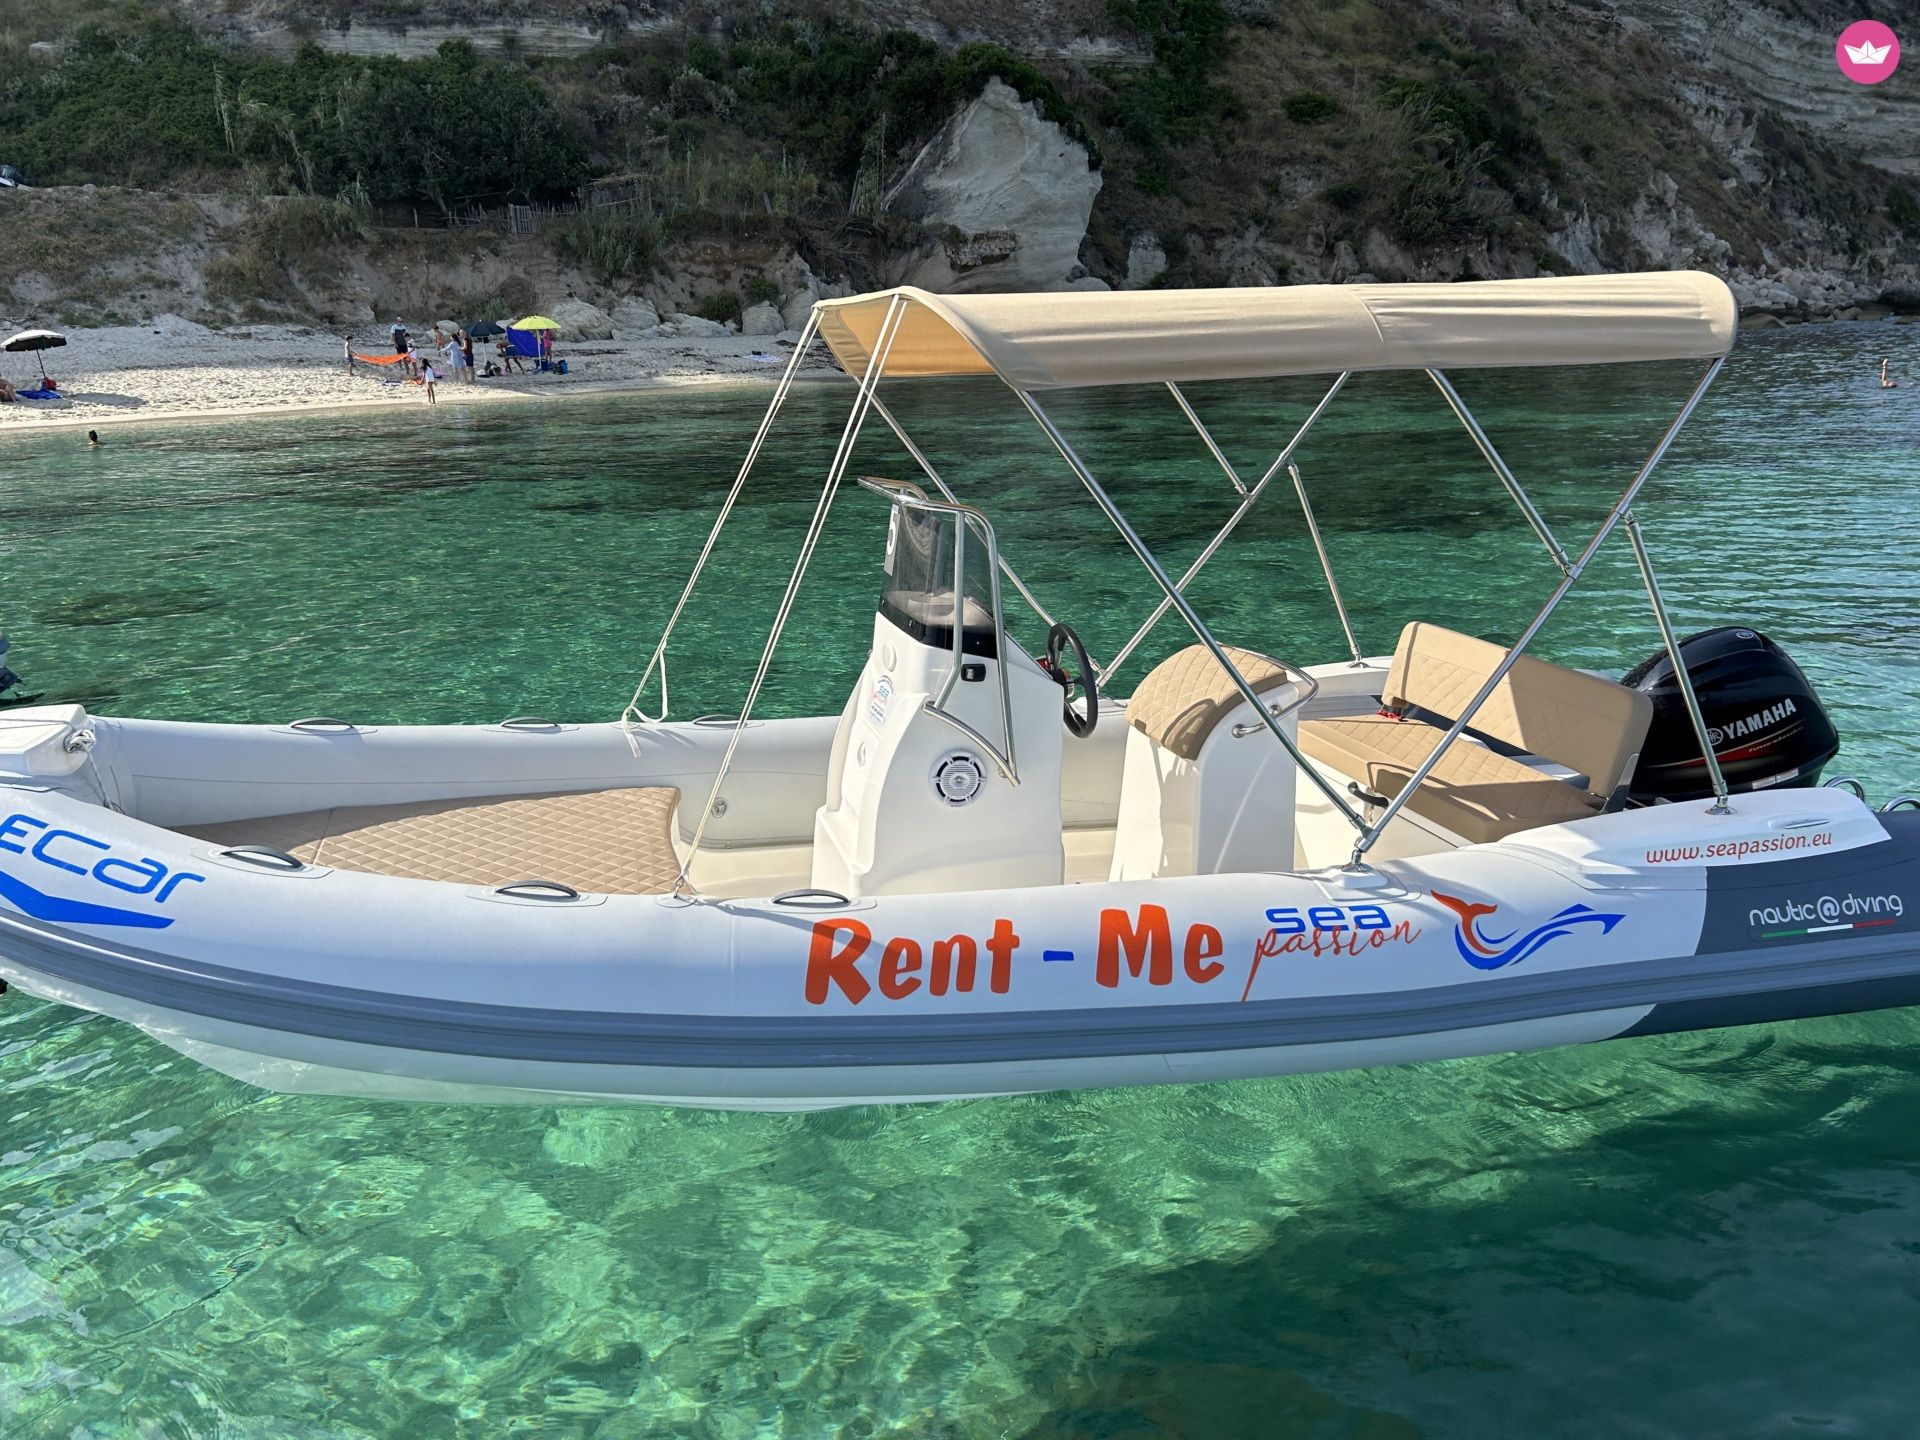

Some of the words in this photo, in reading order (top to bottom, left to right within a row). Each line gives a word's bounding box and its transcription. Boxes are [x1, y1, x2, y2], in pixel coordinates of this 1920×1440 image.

[1722, 698, 1797, 739] YAMAHA
[1646, 832, 1832, 865] www.seapassion.eu
[1265, 905, 1392, 935] sea
[804, 917, 1020, 1006] Rent
[1096, 903, 1225, 988] Me
[1241, 920, 1422, 1003] passion
